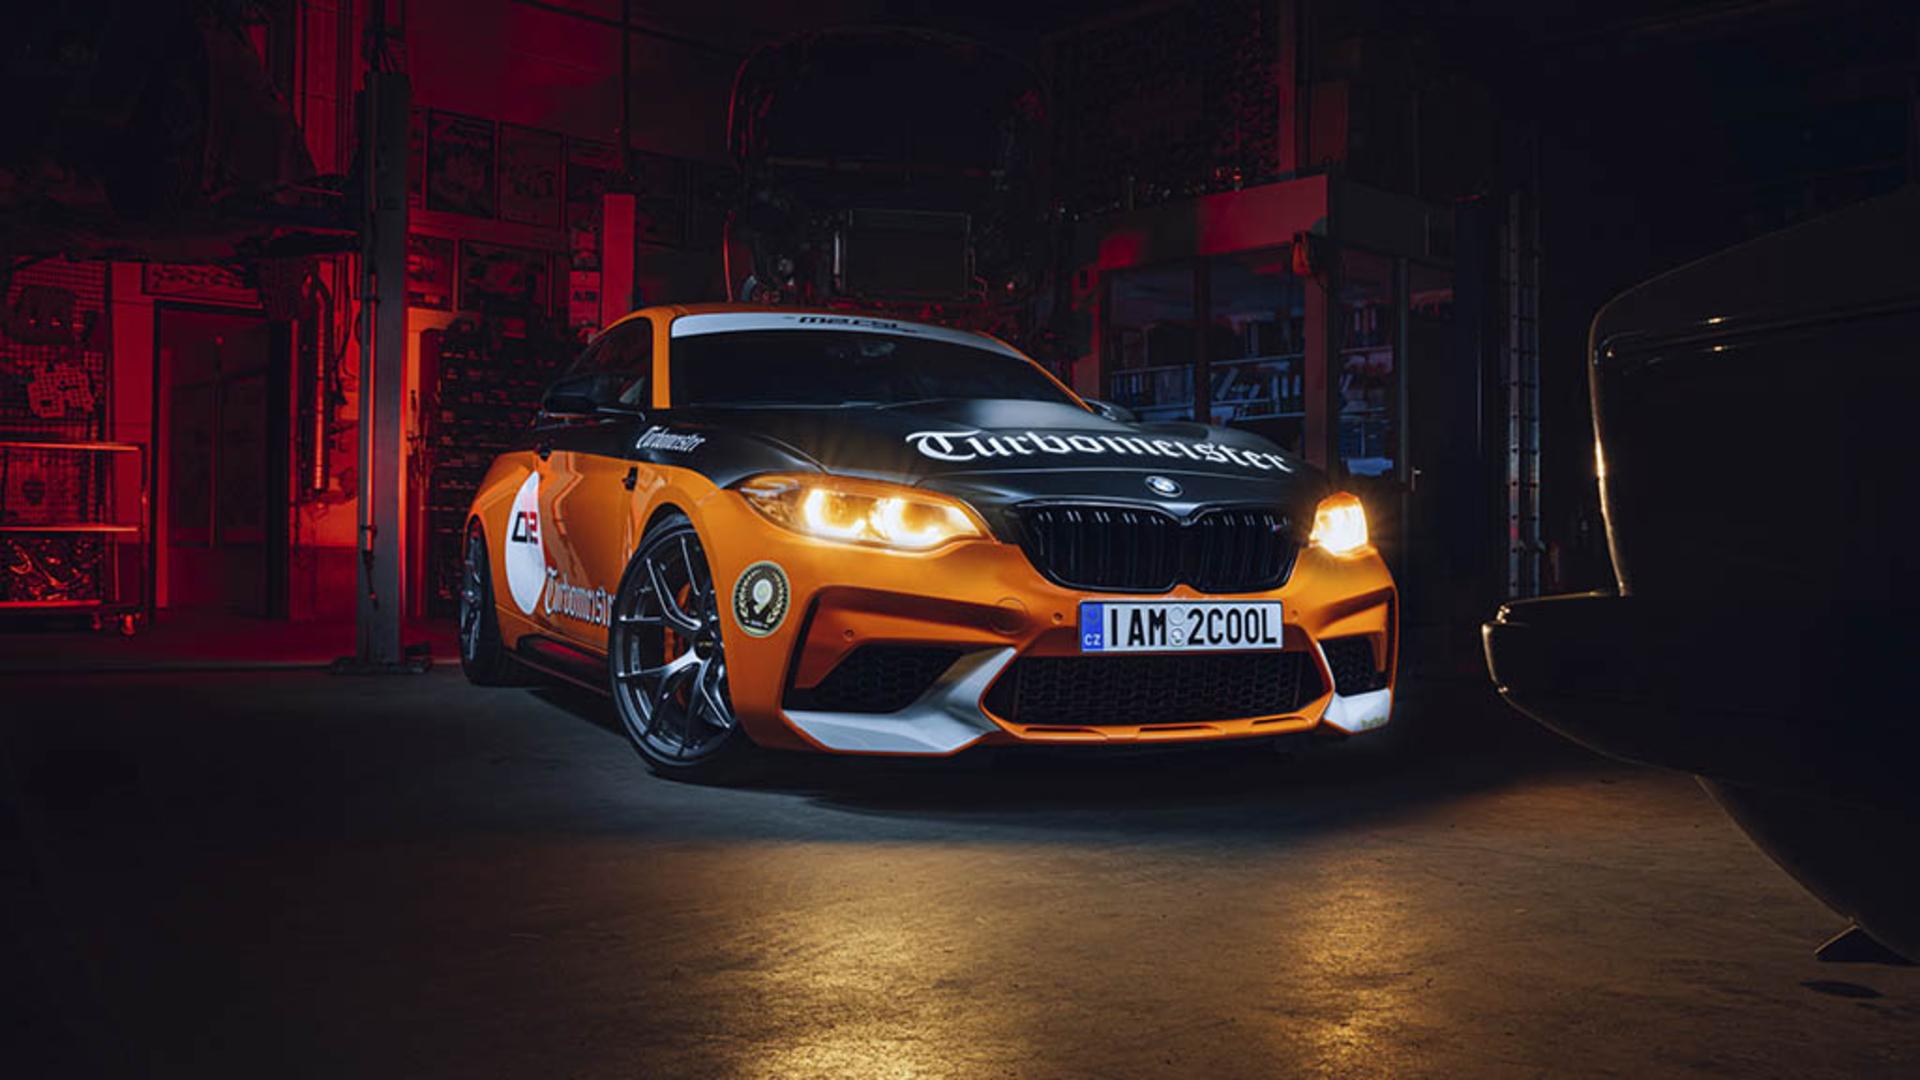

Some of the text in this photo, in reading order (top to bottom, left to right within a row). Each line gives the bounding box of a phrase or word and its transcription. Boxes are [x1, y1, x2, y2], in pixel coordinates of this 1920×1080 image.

[906, 430, 1293, 473] Turbomeister
[1084, 633, 1101, 646] CZ
[1111, 608, 1277, 646] I AM 2COOL
